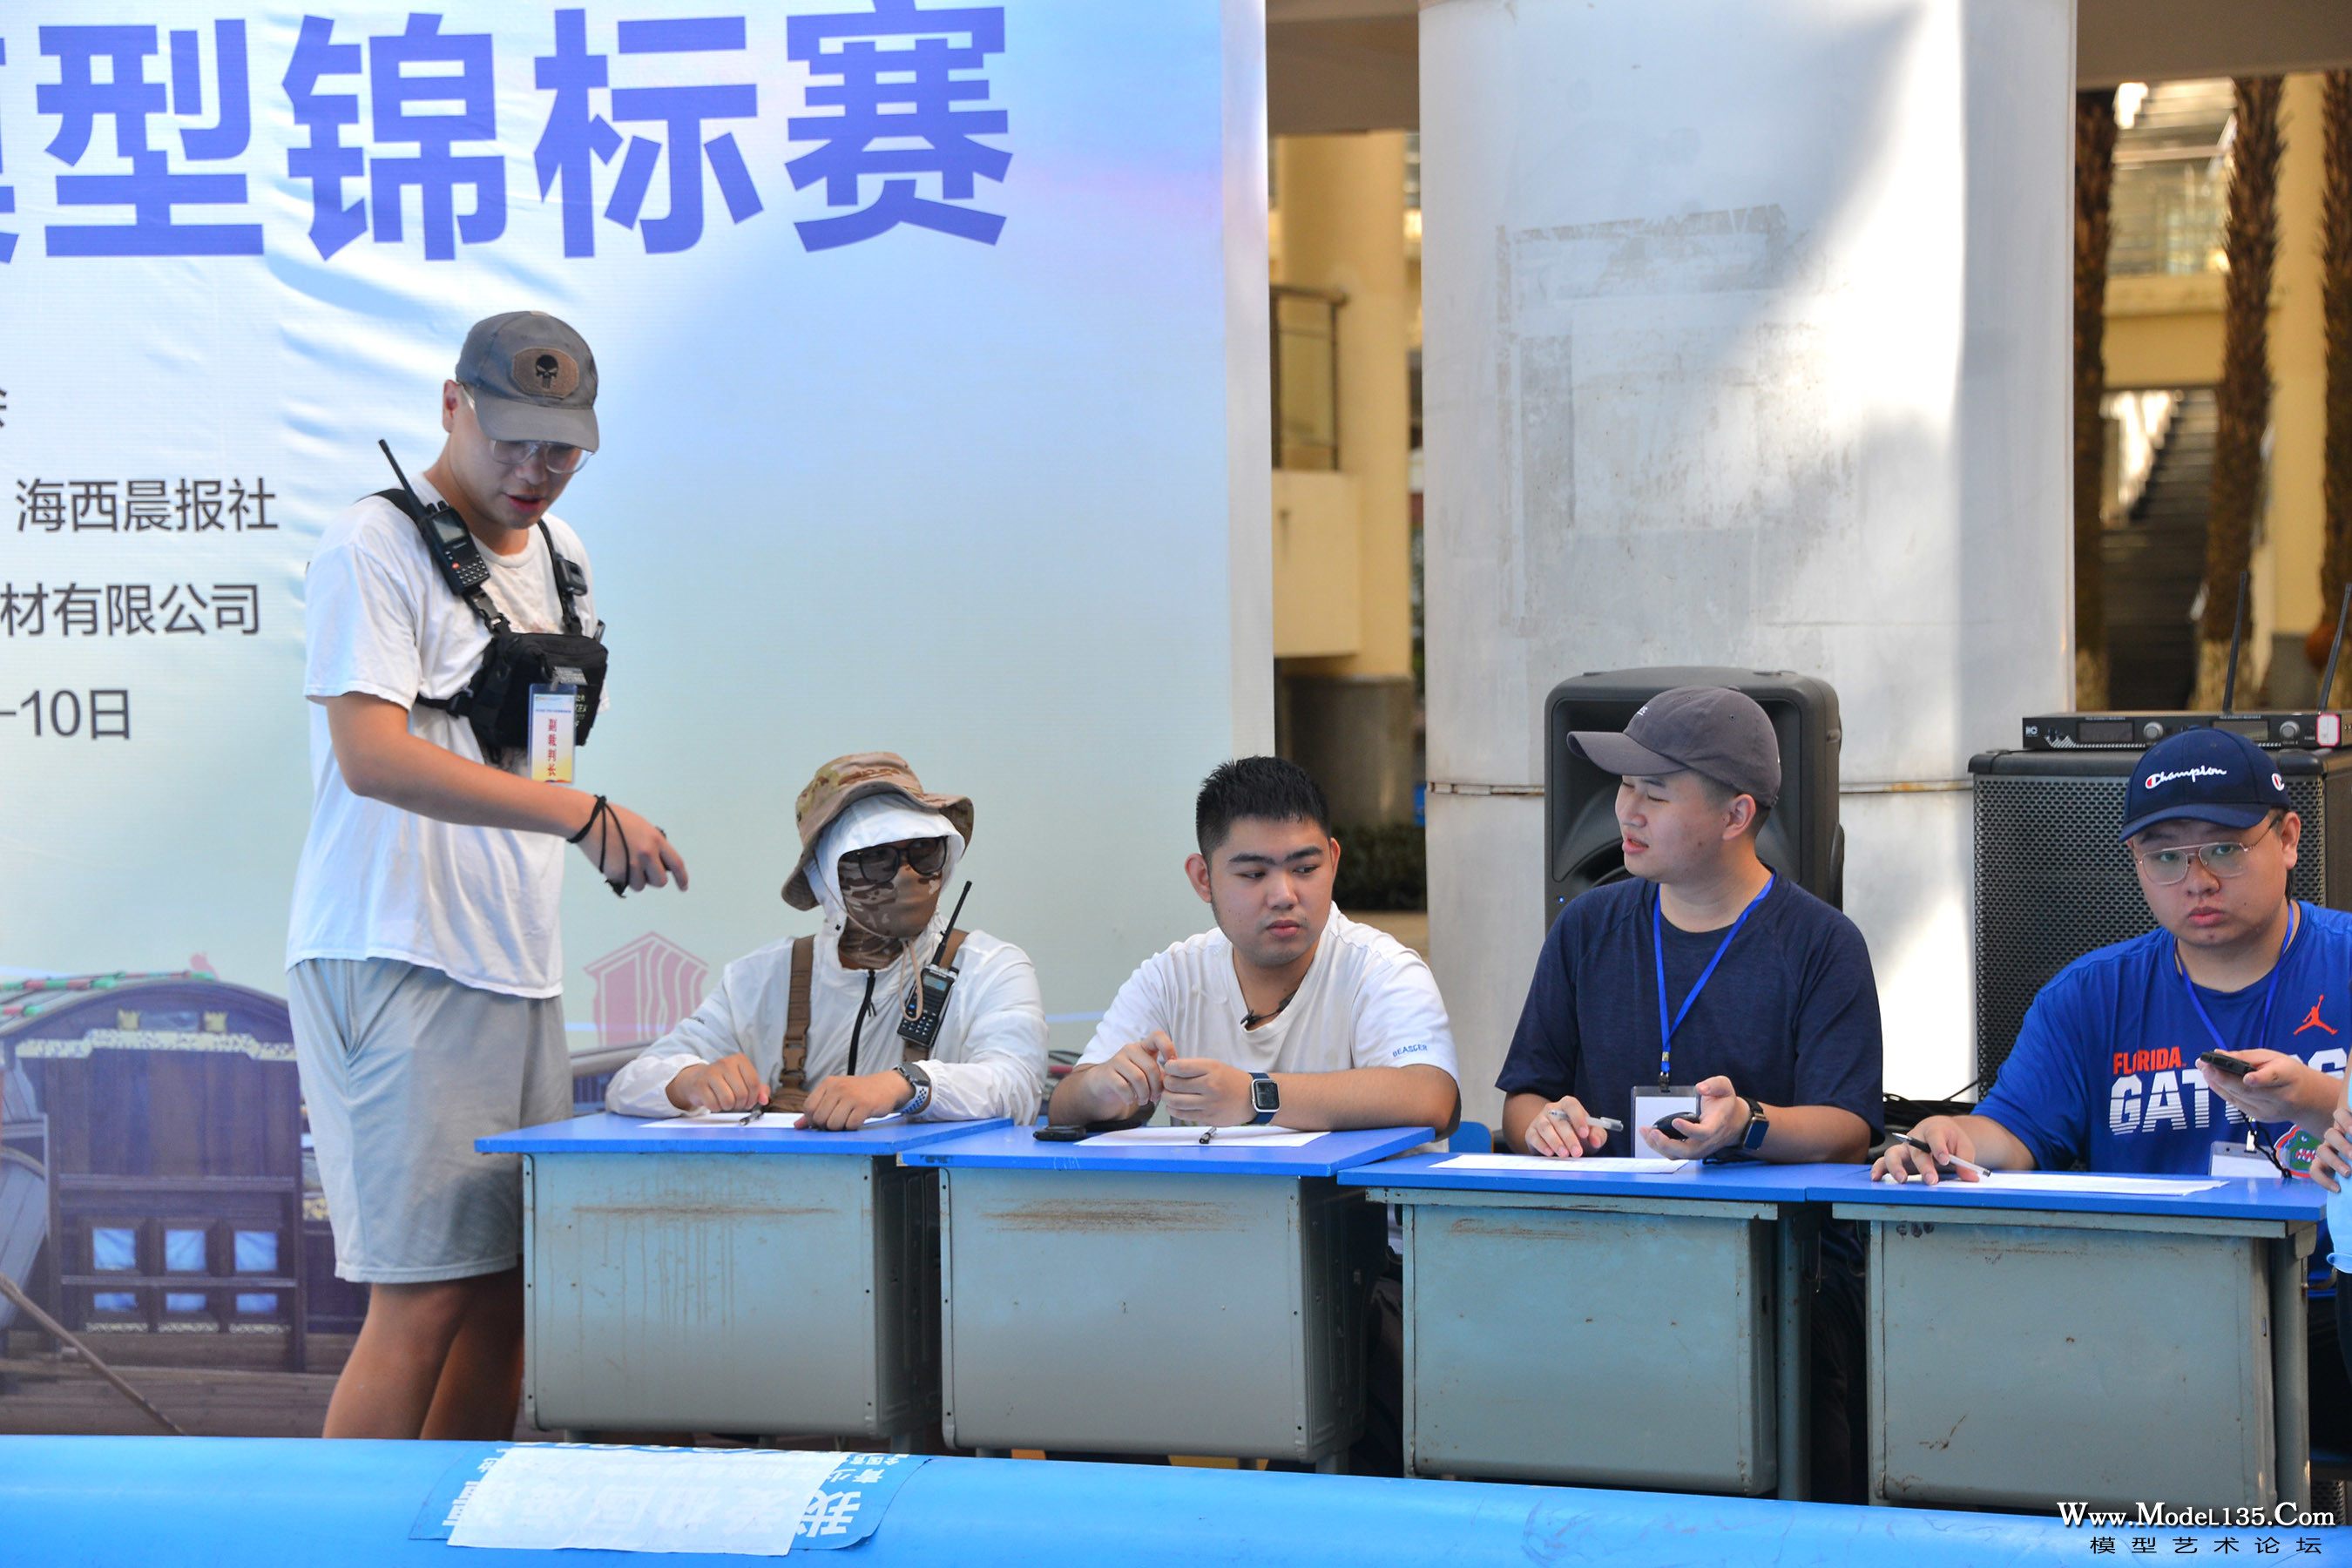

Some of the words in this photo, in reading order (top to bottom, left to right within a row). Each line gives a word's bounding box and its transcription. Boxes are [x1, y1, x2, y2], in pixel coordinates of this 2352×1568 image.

[0, 0, 1013, 263] 型锦标赛
[16, 477, 279, 532] 海西晨报社
[0, 583, 260, 636] 材有限公司
[2145, 765, 2227, 789] Champion
